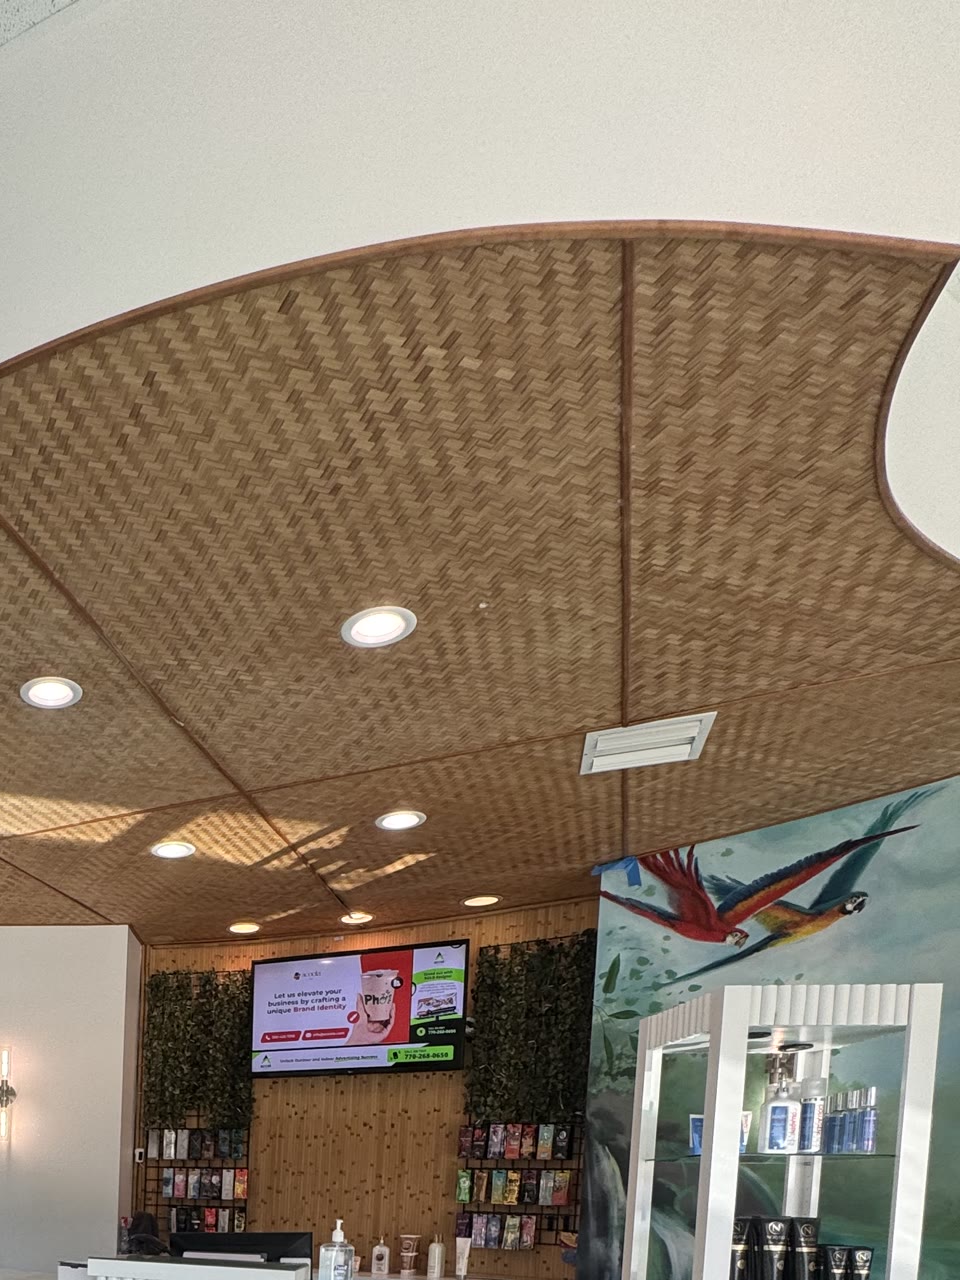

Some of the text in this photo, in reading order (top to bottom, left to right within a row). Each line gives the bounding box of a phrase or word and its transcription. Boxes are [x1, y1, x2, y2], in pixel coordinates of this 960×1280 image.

[311, 996, 340, 1004] crafting
[317, 1003, 347, 1011] Identity
[404, 1052, 449, 1060] 770-268-0650
